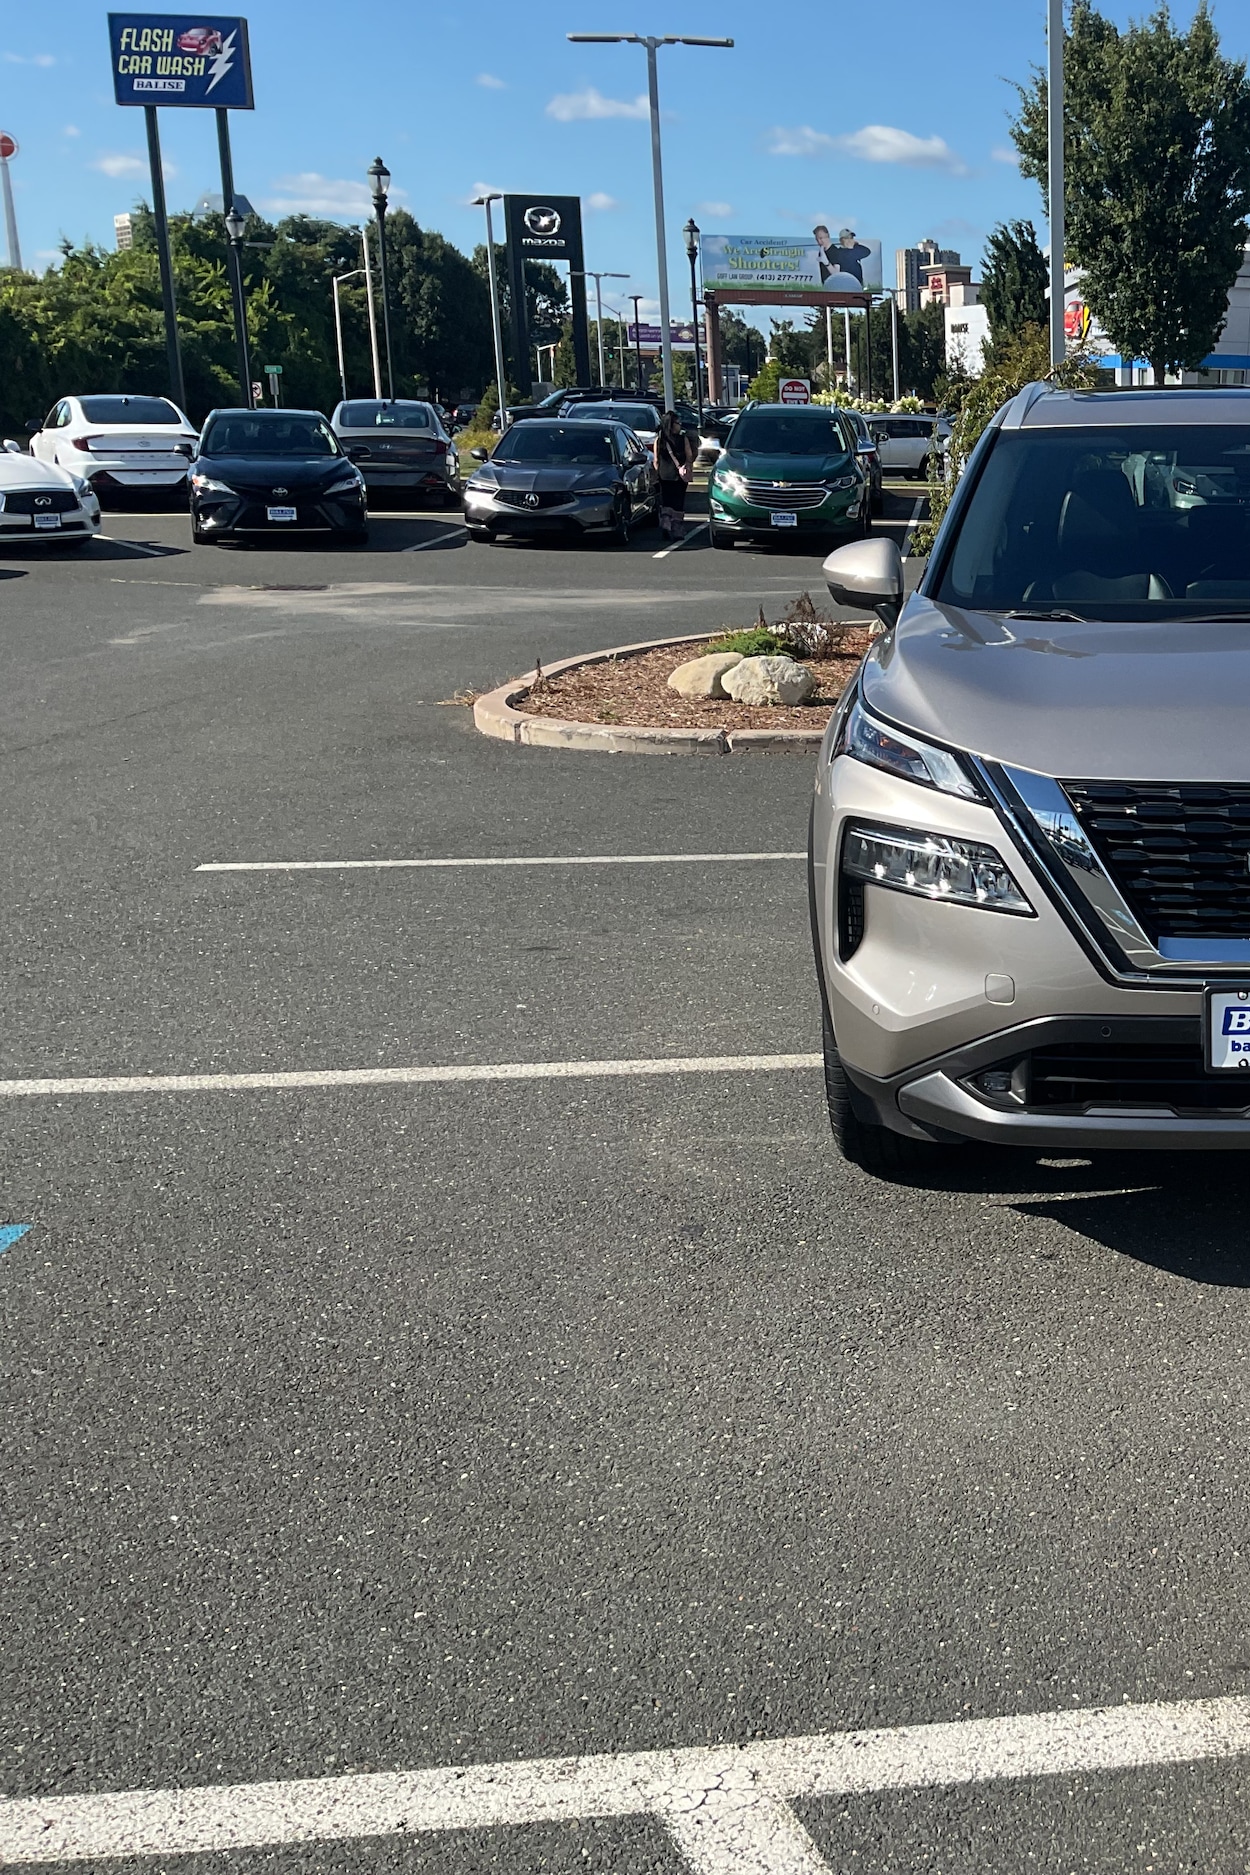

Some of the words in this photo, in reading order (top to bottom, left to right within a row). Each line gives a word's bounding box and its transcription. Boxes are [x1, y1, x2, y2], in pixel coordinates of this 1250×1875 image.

[120, 28, 174, 52] FLASH
[118, 55, 153, 75] CAR
[156, 56, 206, 76] WASH
[136, 80, 184, 90] BALISE
[723, 245, 740, 255] We
[743, 247, 761, 256] Are
[762, 247, 805, 258] Straight
[728, 257, 801, 271] Shooters!
[777, 274, 814, 282] 277-7777
